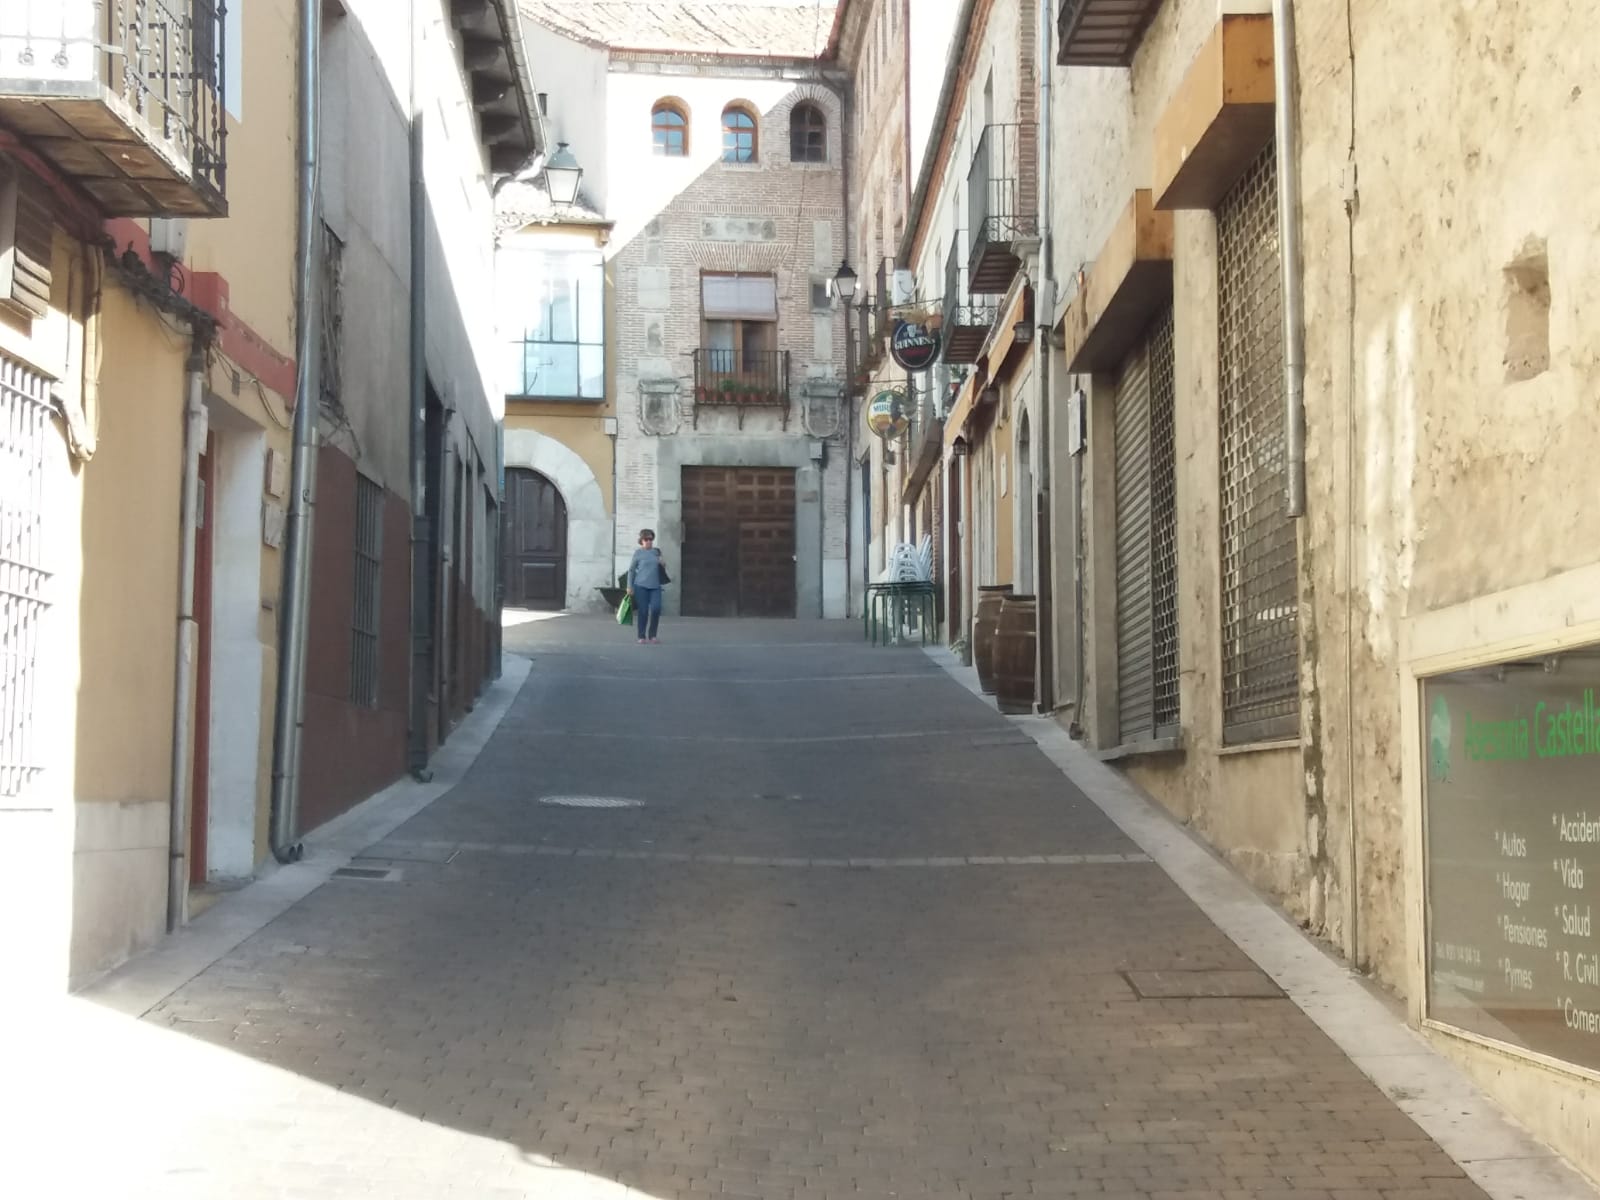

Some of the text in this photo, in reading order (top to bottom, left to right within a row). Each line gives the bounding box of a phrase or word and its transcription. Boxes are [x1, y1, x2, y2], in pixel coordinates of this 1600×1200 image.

[1501, 831, 1527, 857] Autos
[1560, 812, 1600, 843] Acciden
[1502, 872, 1530, 907] Hogar
[1560, 858, 1584, 889] Vida
[1503, 914, 1548, 948] Pensiones
[1562, 904, 1591, 937] Salud
[1504, 957, 1533, 993] Pymes
[1563, 950, 1599, 986] R. Civil
